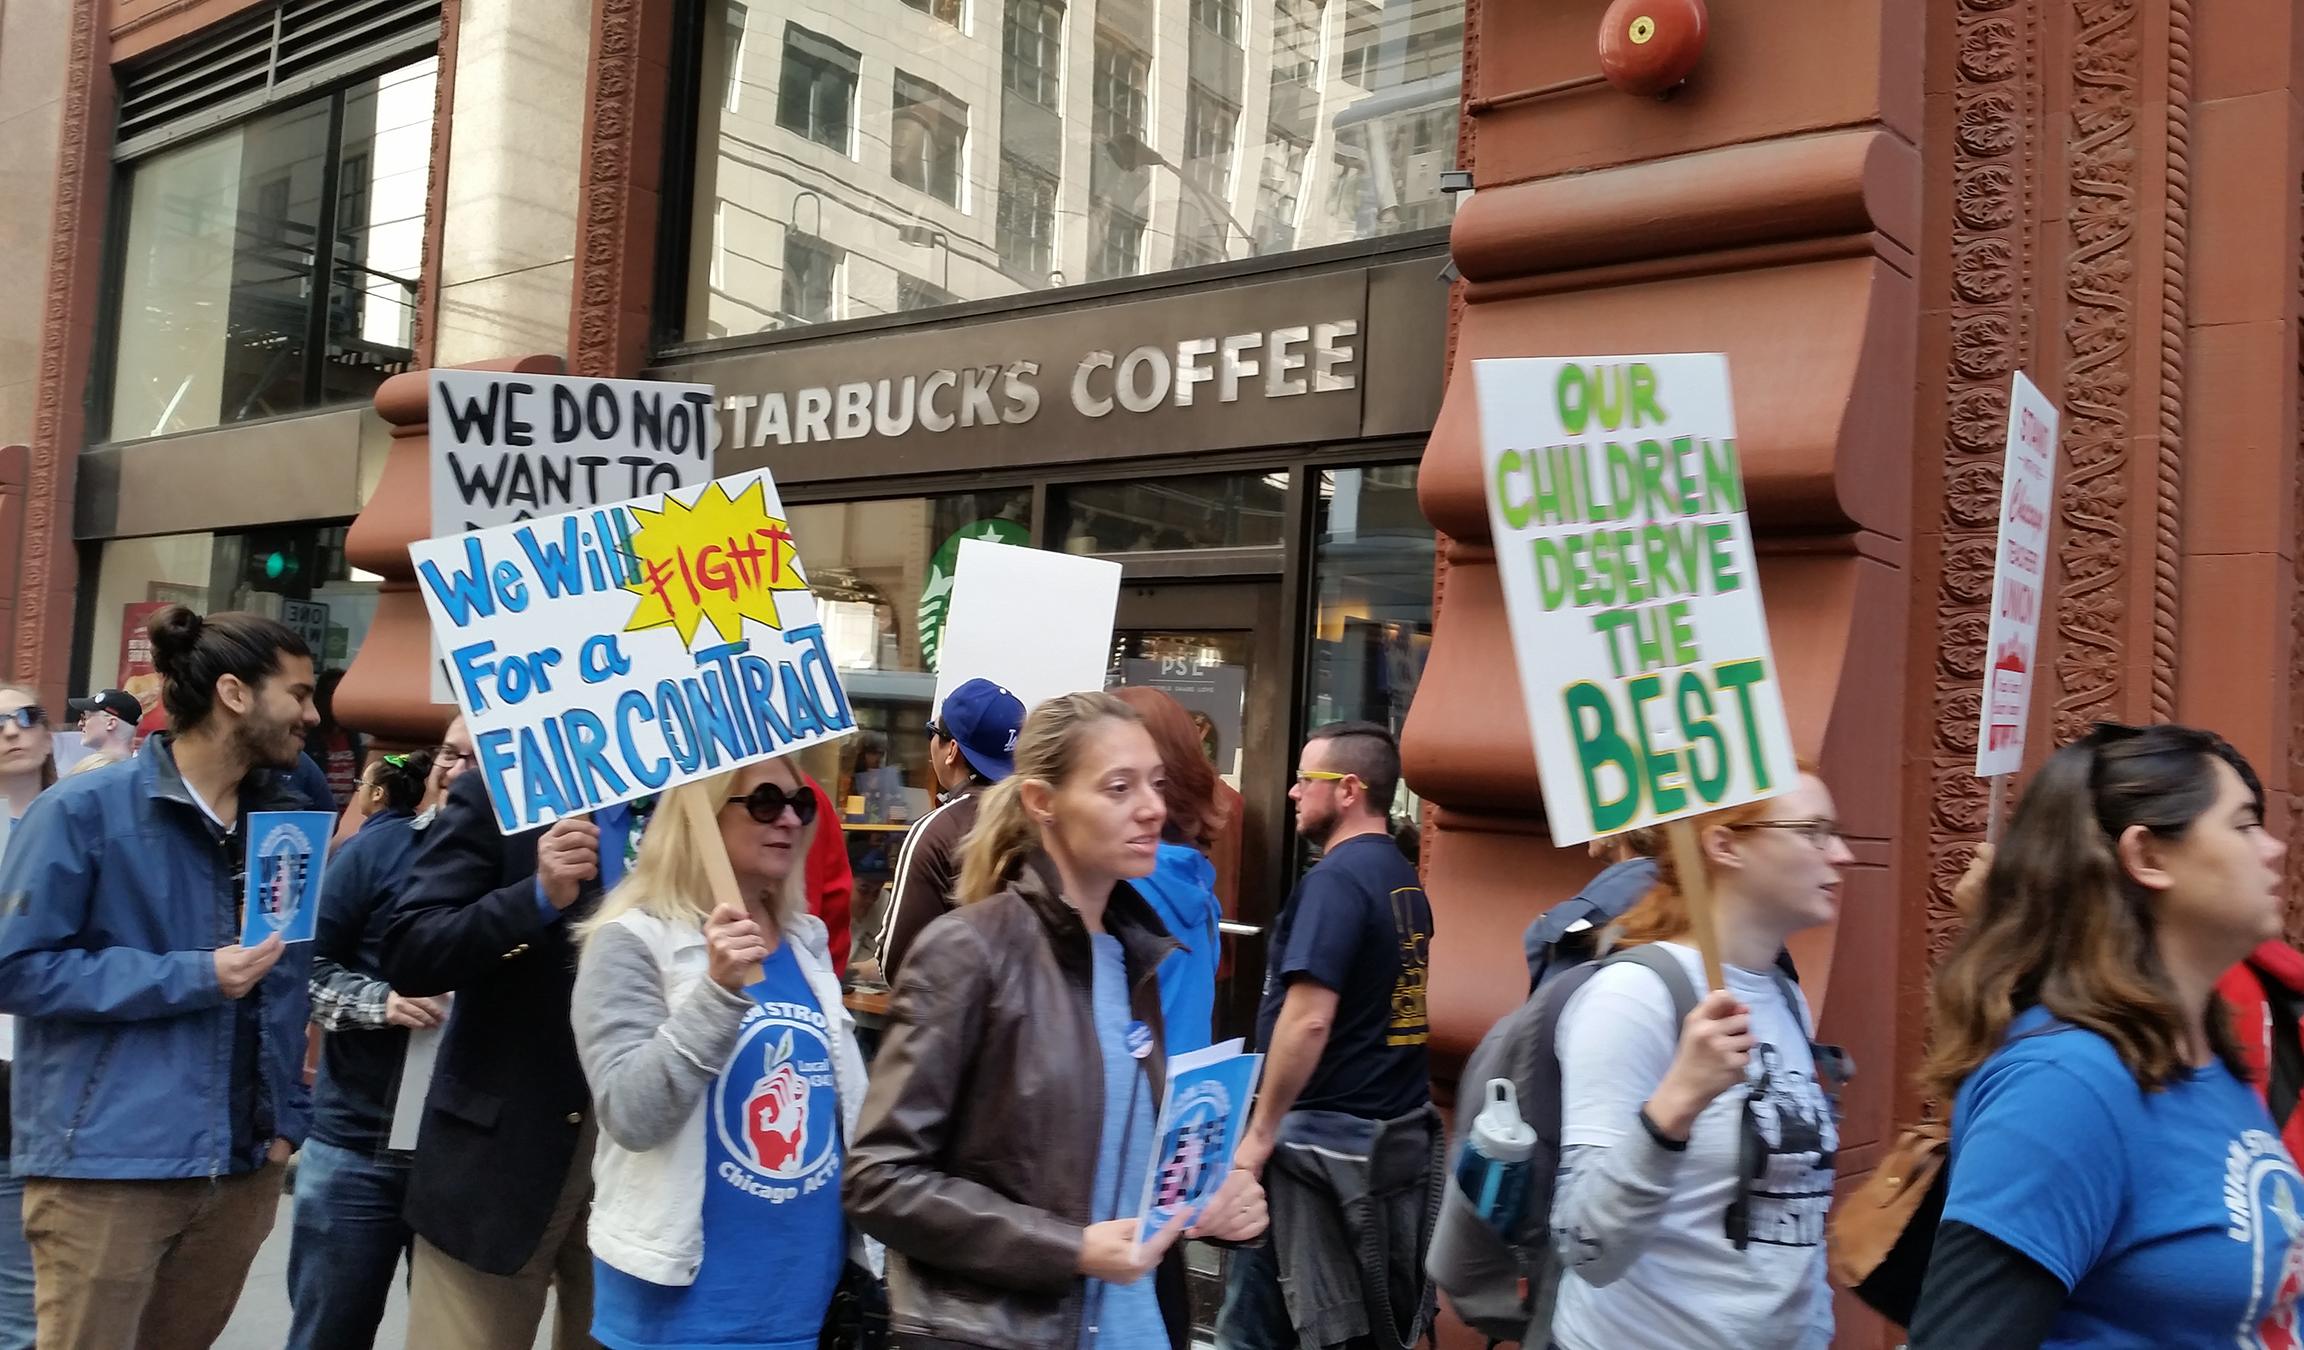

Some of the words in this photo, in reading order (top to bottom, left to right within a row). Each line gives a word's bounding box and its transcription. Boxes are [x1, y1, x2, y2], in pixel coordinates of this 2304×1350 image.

[1070, 319, 1358, 418] COFFEE
[1556, 362, 1669, 436] OUR
[439, 381, 534, 447] WE
[553, 382, 620, 444] DO
[634, 390, 714, 461] NOT
[447, 452, 610, 510] WANT
[619, 456, 681, 498] TO
[1497, 434, 1746, 531] CHILDREN
[418, 536, 529, 628] We
[513, 506, 643, 598] Will
[645, 525, 794, 618] FIGHT
[1533, 522, 1743, 612] DESERVE
[452, 640, 562, 716] For
[579, 630, 632, 685] a
[1592, 600, 1700, 679] THE
[476, 707, 628, 832] FAIR
[614, 624, 857, 789] CONTRACT
[1563, 657, 1775, 836] BEST
[798, 1058, 830, 1072] Local
[718, 1161, 798, 1204] Chicago
[803, 1153, 840, 1195] ACTS
